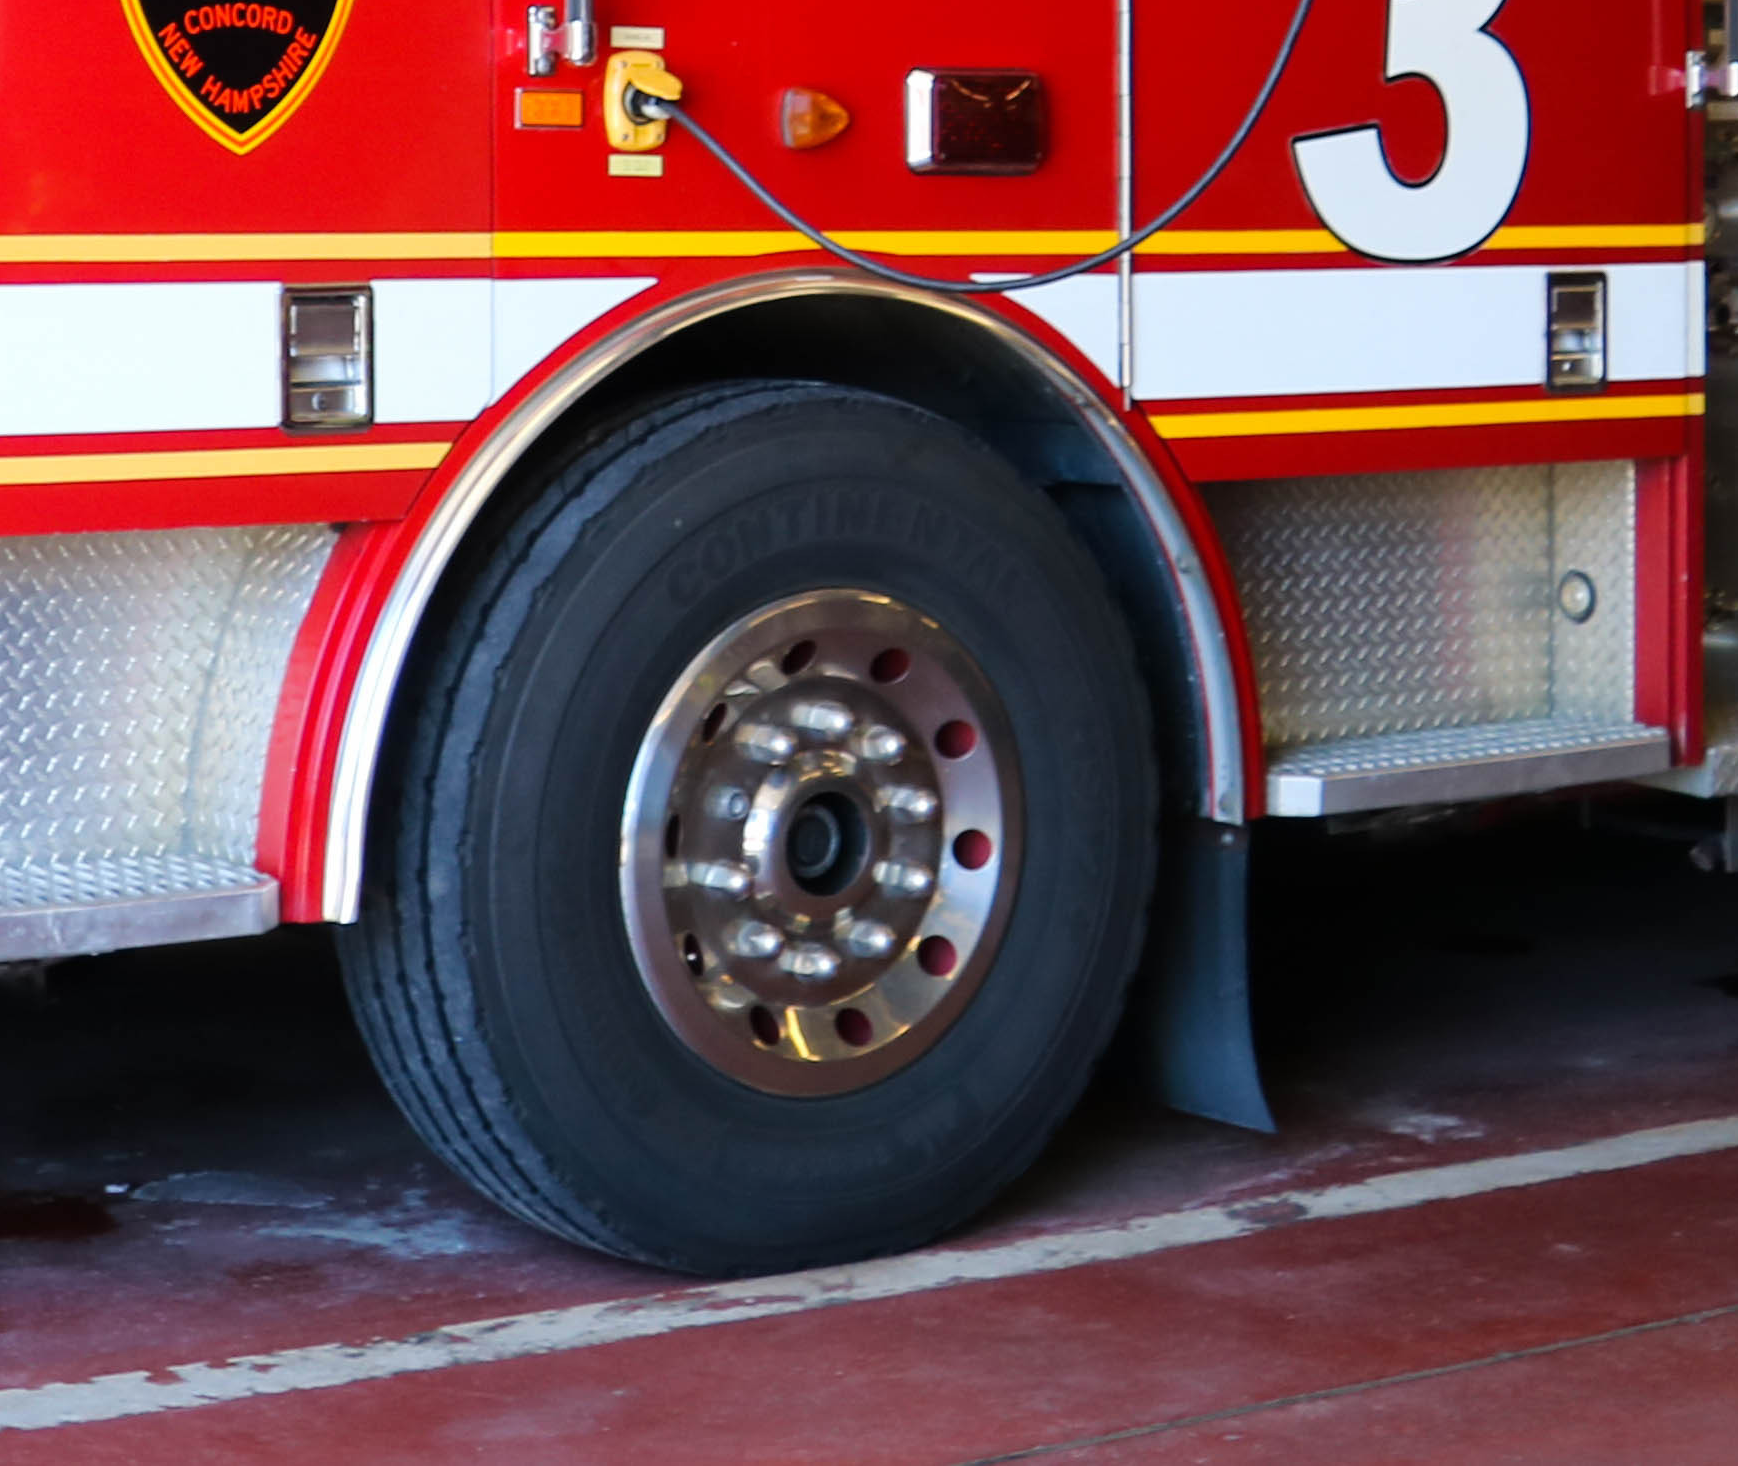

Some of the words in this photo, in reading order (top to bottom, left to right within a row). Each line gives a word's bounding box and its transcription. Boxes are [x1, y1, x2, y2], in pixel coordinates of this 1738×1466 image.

[183, 2, 294, 36] CONCORD
[158, 22, 204, 79] NEW
[200, 25, 318, 114] HAMPSHIRE
[665, 484, 1031, 608] CONTINENTAL
